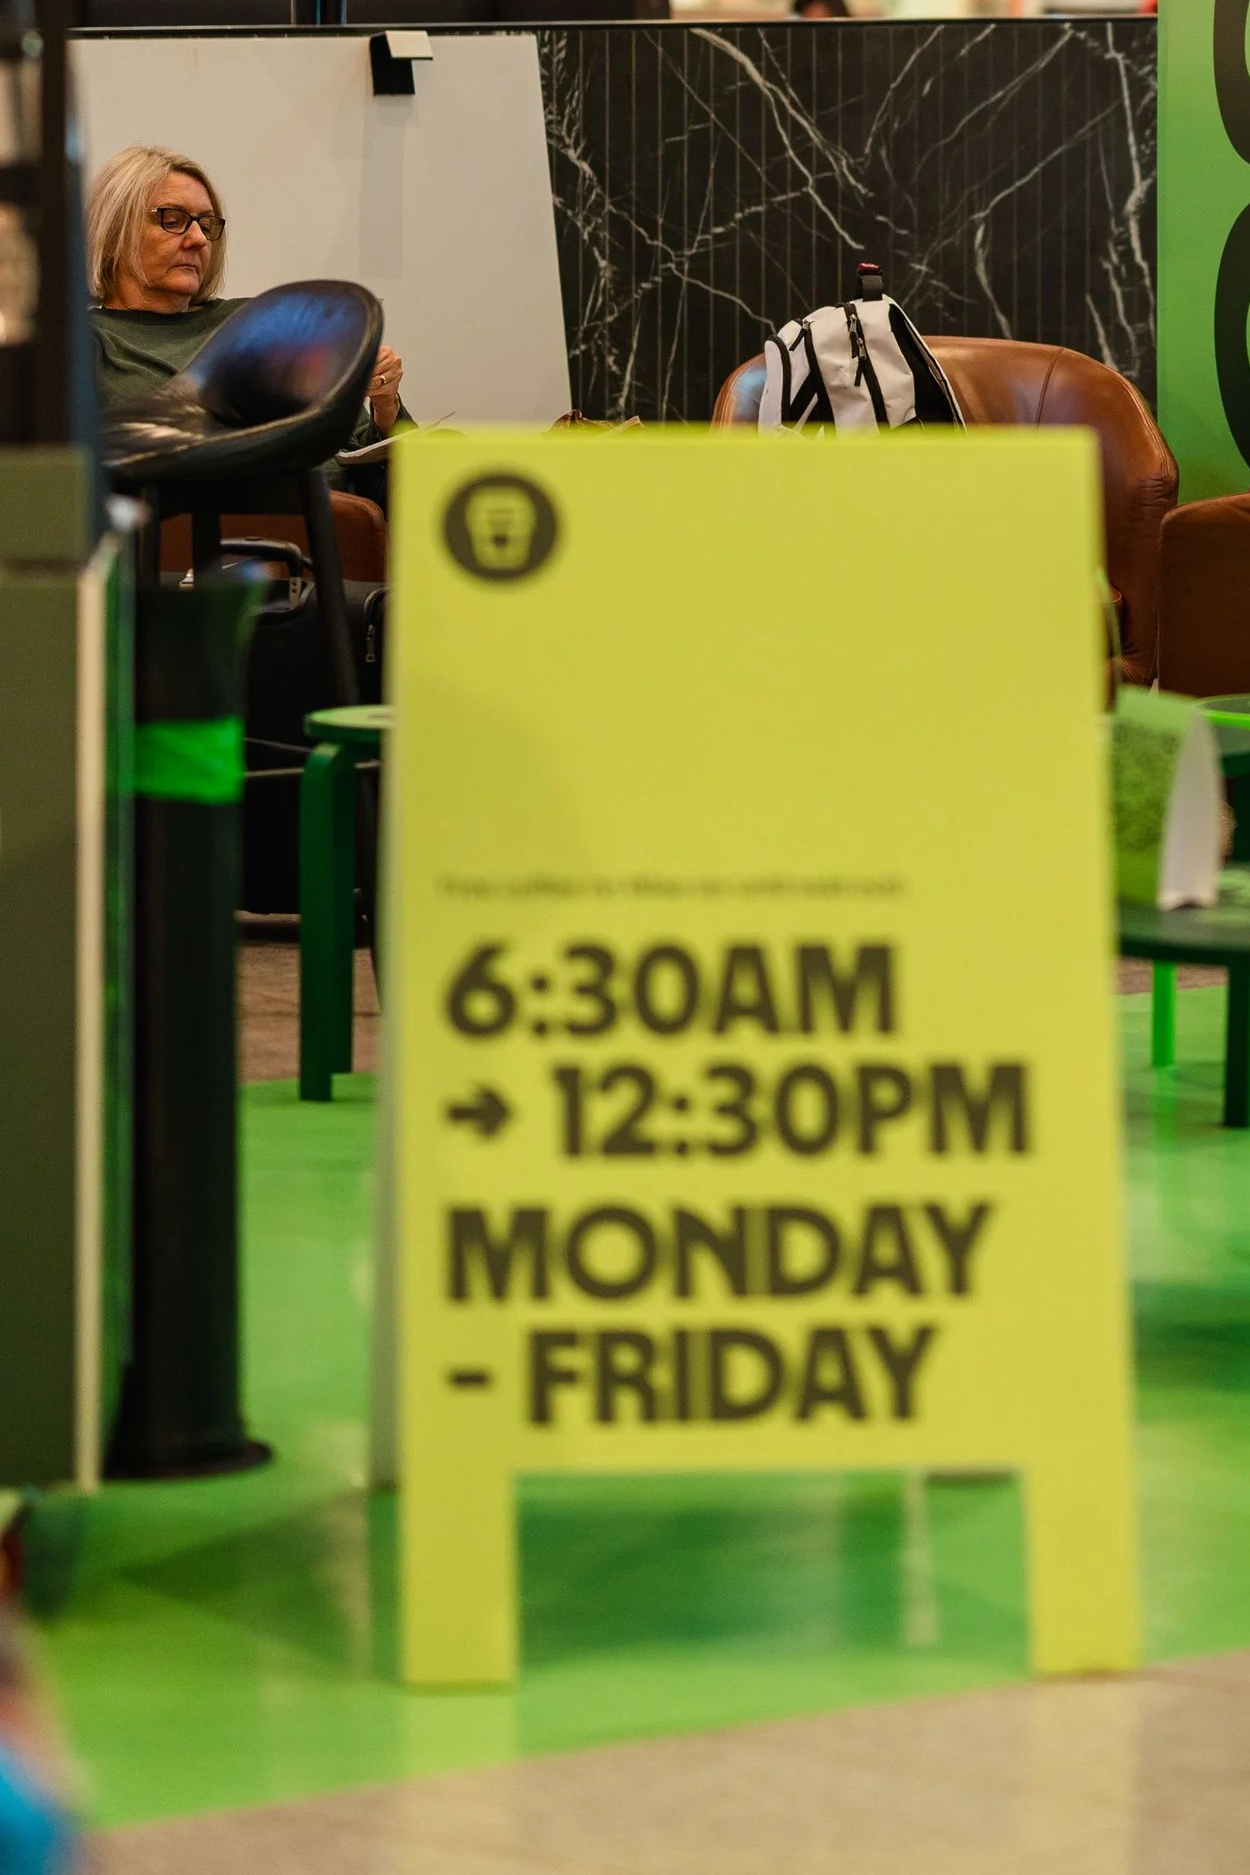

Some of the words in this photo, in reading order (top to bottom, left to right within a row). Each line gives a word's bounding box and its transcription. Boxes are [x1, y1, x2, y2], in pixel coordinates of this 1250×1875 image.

[445, 939, 900, 1039] 6:30AM
[550, 1061, 1032, 1160] 12:30PM
[445, 1201, 994, 1303] MONDAY
[525, 1324, 937, 1427] FRIDAY
